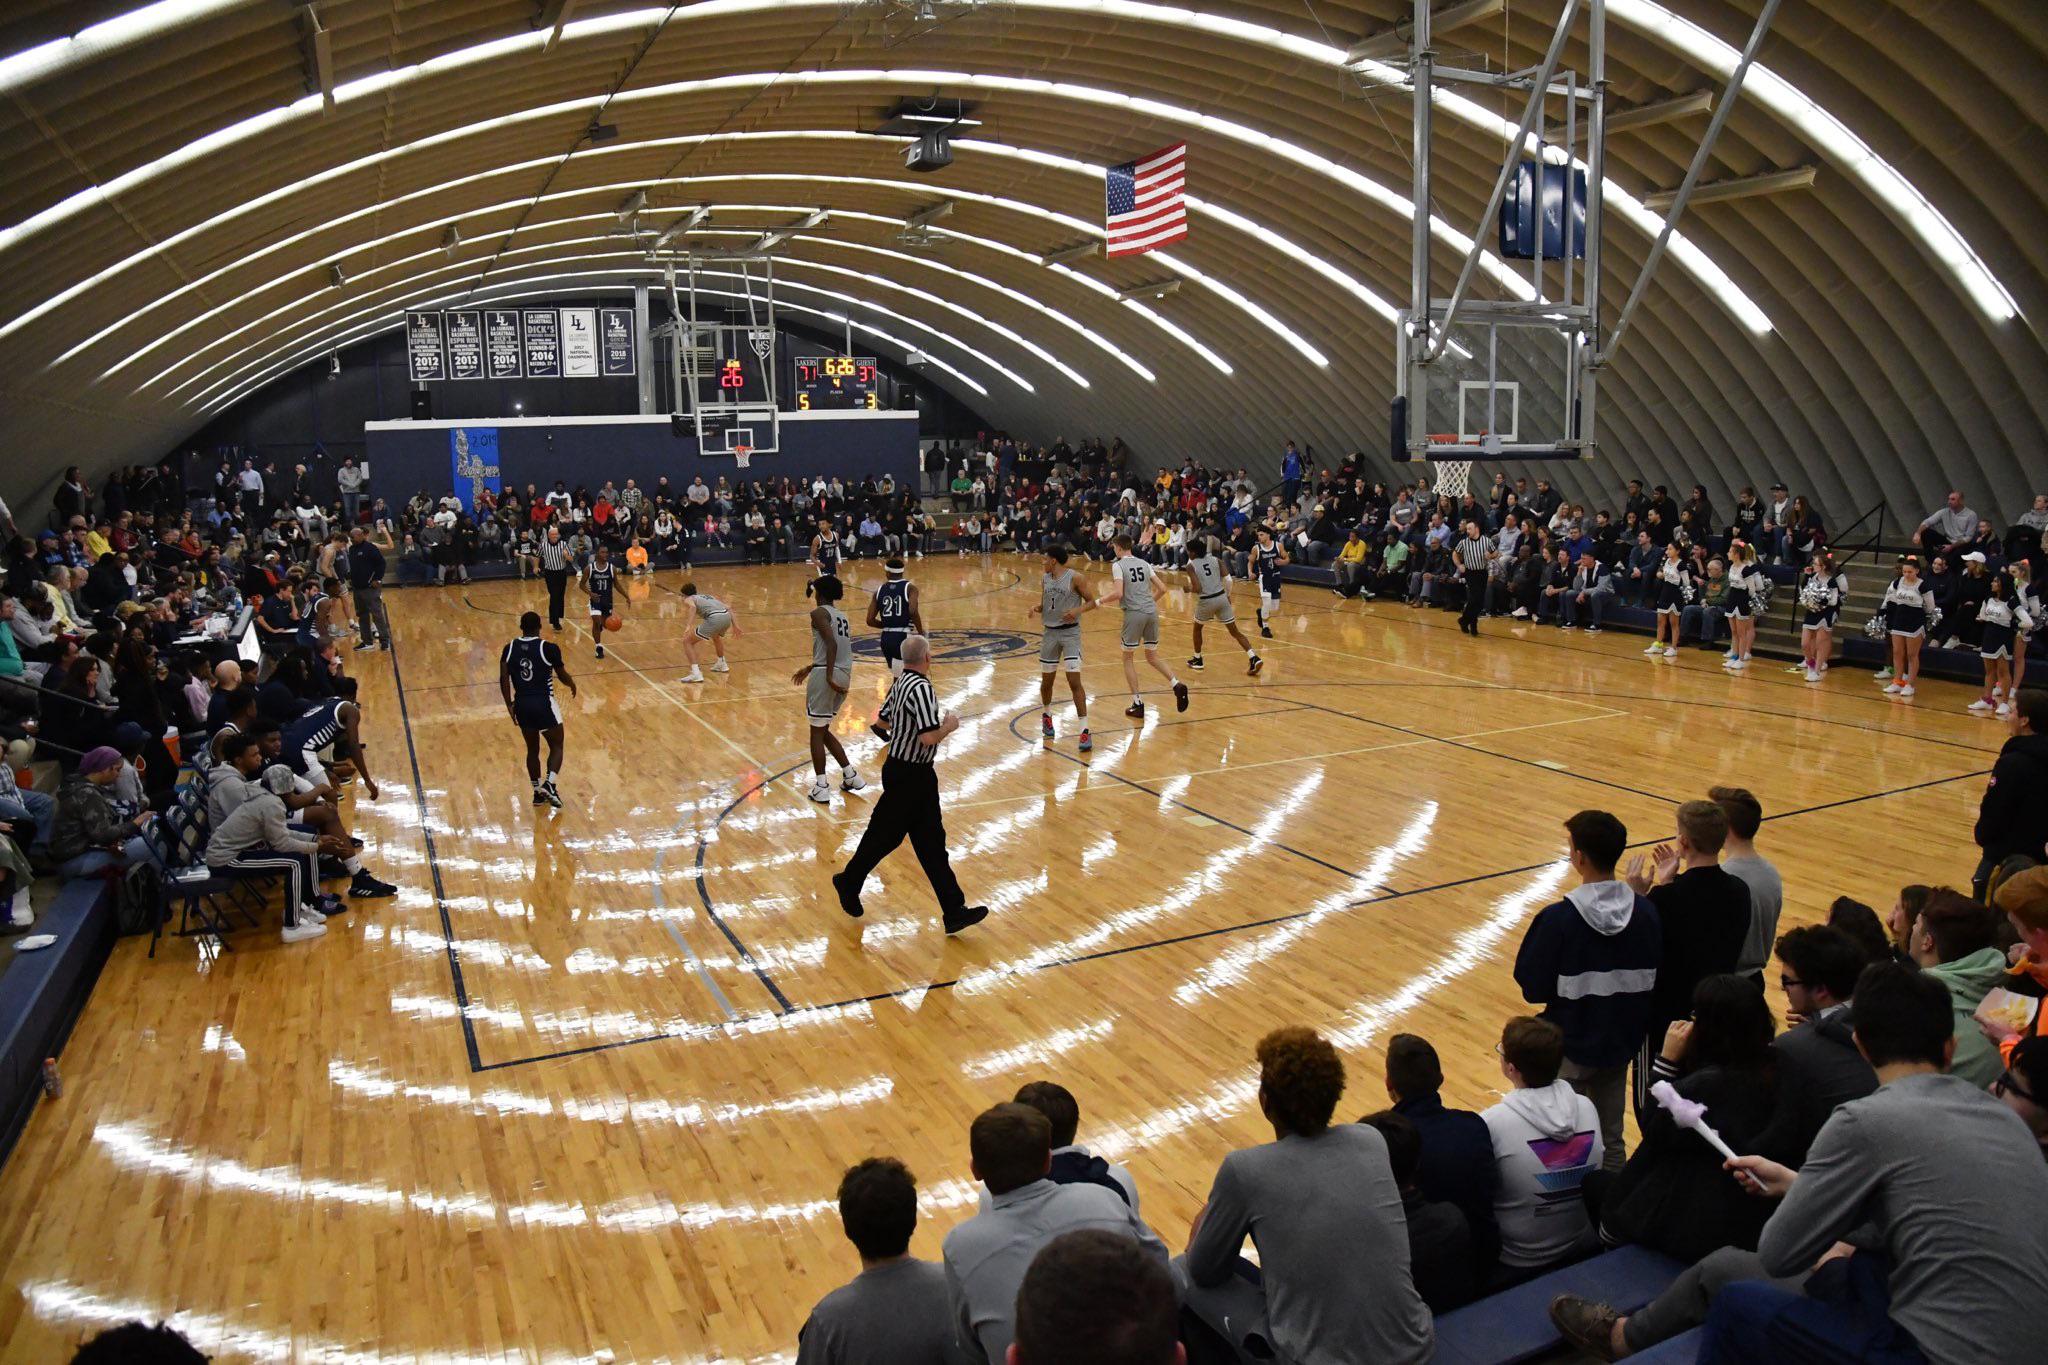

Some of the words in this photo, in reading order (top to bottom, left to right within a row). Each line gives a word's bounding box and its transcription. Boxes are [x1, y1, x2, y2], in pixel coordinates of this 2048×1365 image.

[415, 357, 439, 366] 2012
[455, 356, 478, 365] 2013
[493, 355, 516, 364] 2014
[532, 352, 554, 360] 2016
[800, 366, 816, 381] 71
[826, 358, 854, 375] 6:26
[860, 366, 875, 382] 37
[722, 367, 743, 387] 26
[833, 378, 840, 388] 4
[800, 394, 809, 410] 5
[868, 394, 875, 409] 3
[1129, 567, 1145, 582] 35
[1203, 563, 1212, 576] 5
[882, 595, 902, 617] 21
[1051, 598, 1055, 609] 1
[837, 617, 850, 638] 22
[520, 658, 533, 681] 3
